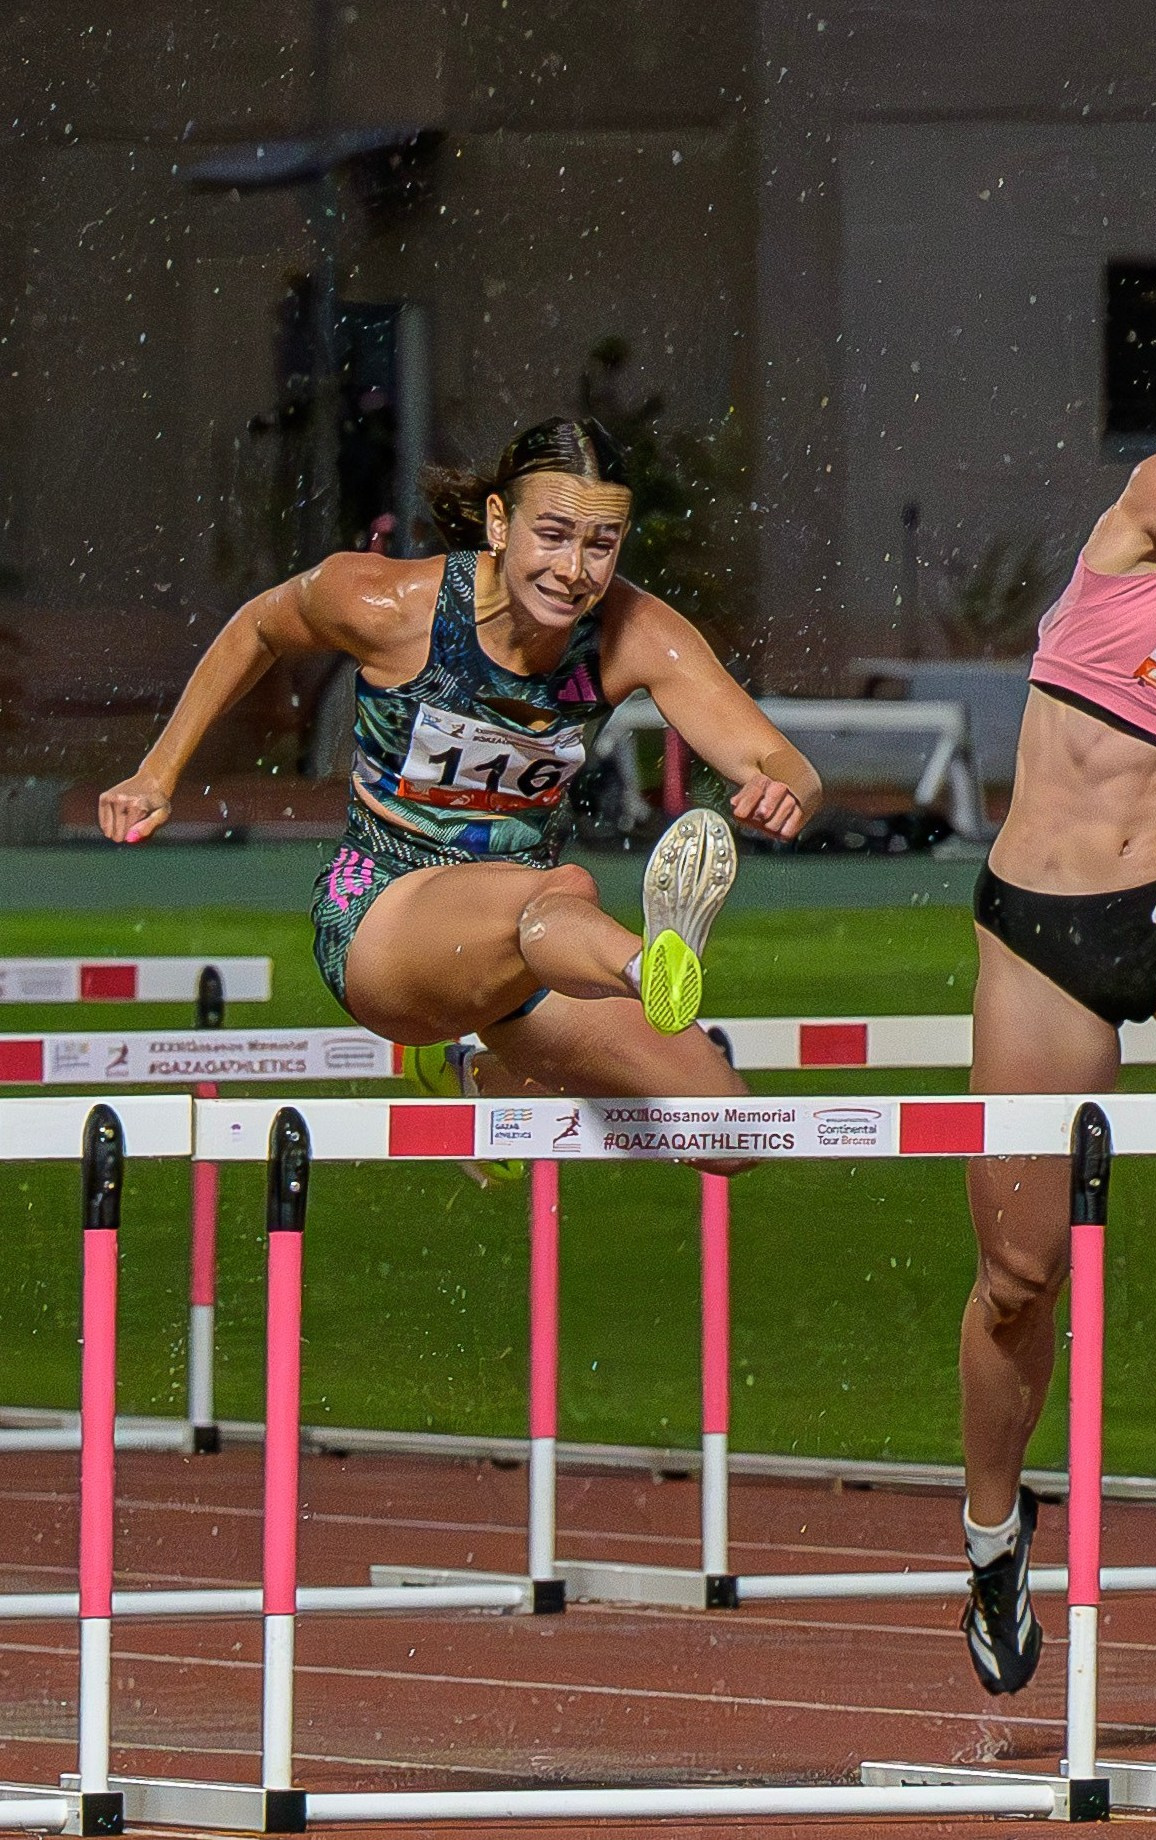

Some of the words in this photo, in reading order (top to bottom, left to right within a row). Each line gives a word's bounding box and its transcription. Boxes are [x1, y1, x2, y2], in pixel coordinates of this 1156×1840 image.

[428, 747, 568, 797] 116
[724, 1108, 796, 1123] Memorial
[817, 1123, 877, 1134] Continental
[603, 1132, 795, 1151] #QAZAQATHLETICS
[817, 1135, 840, 1145] Tour
